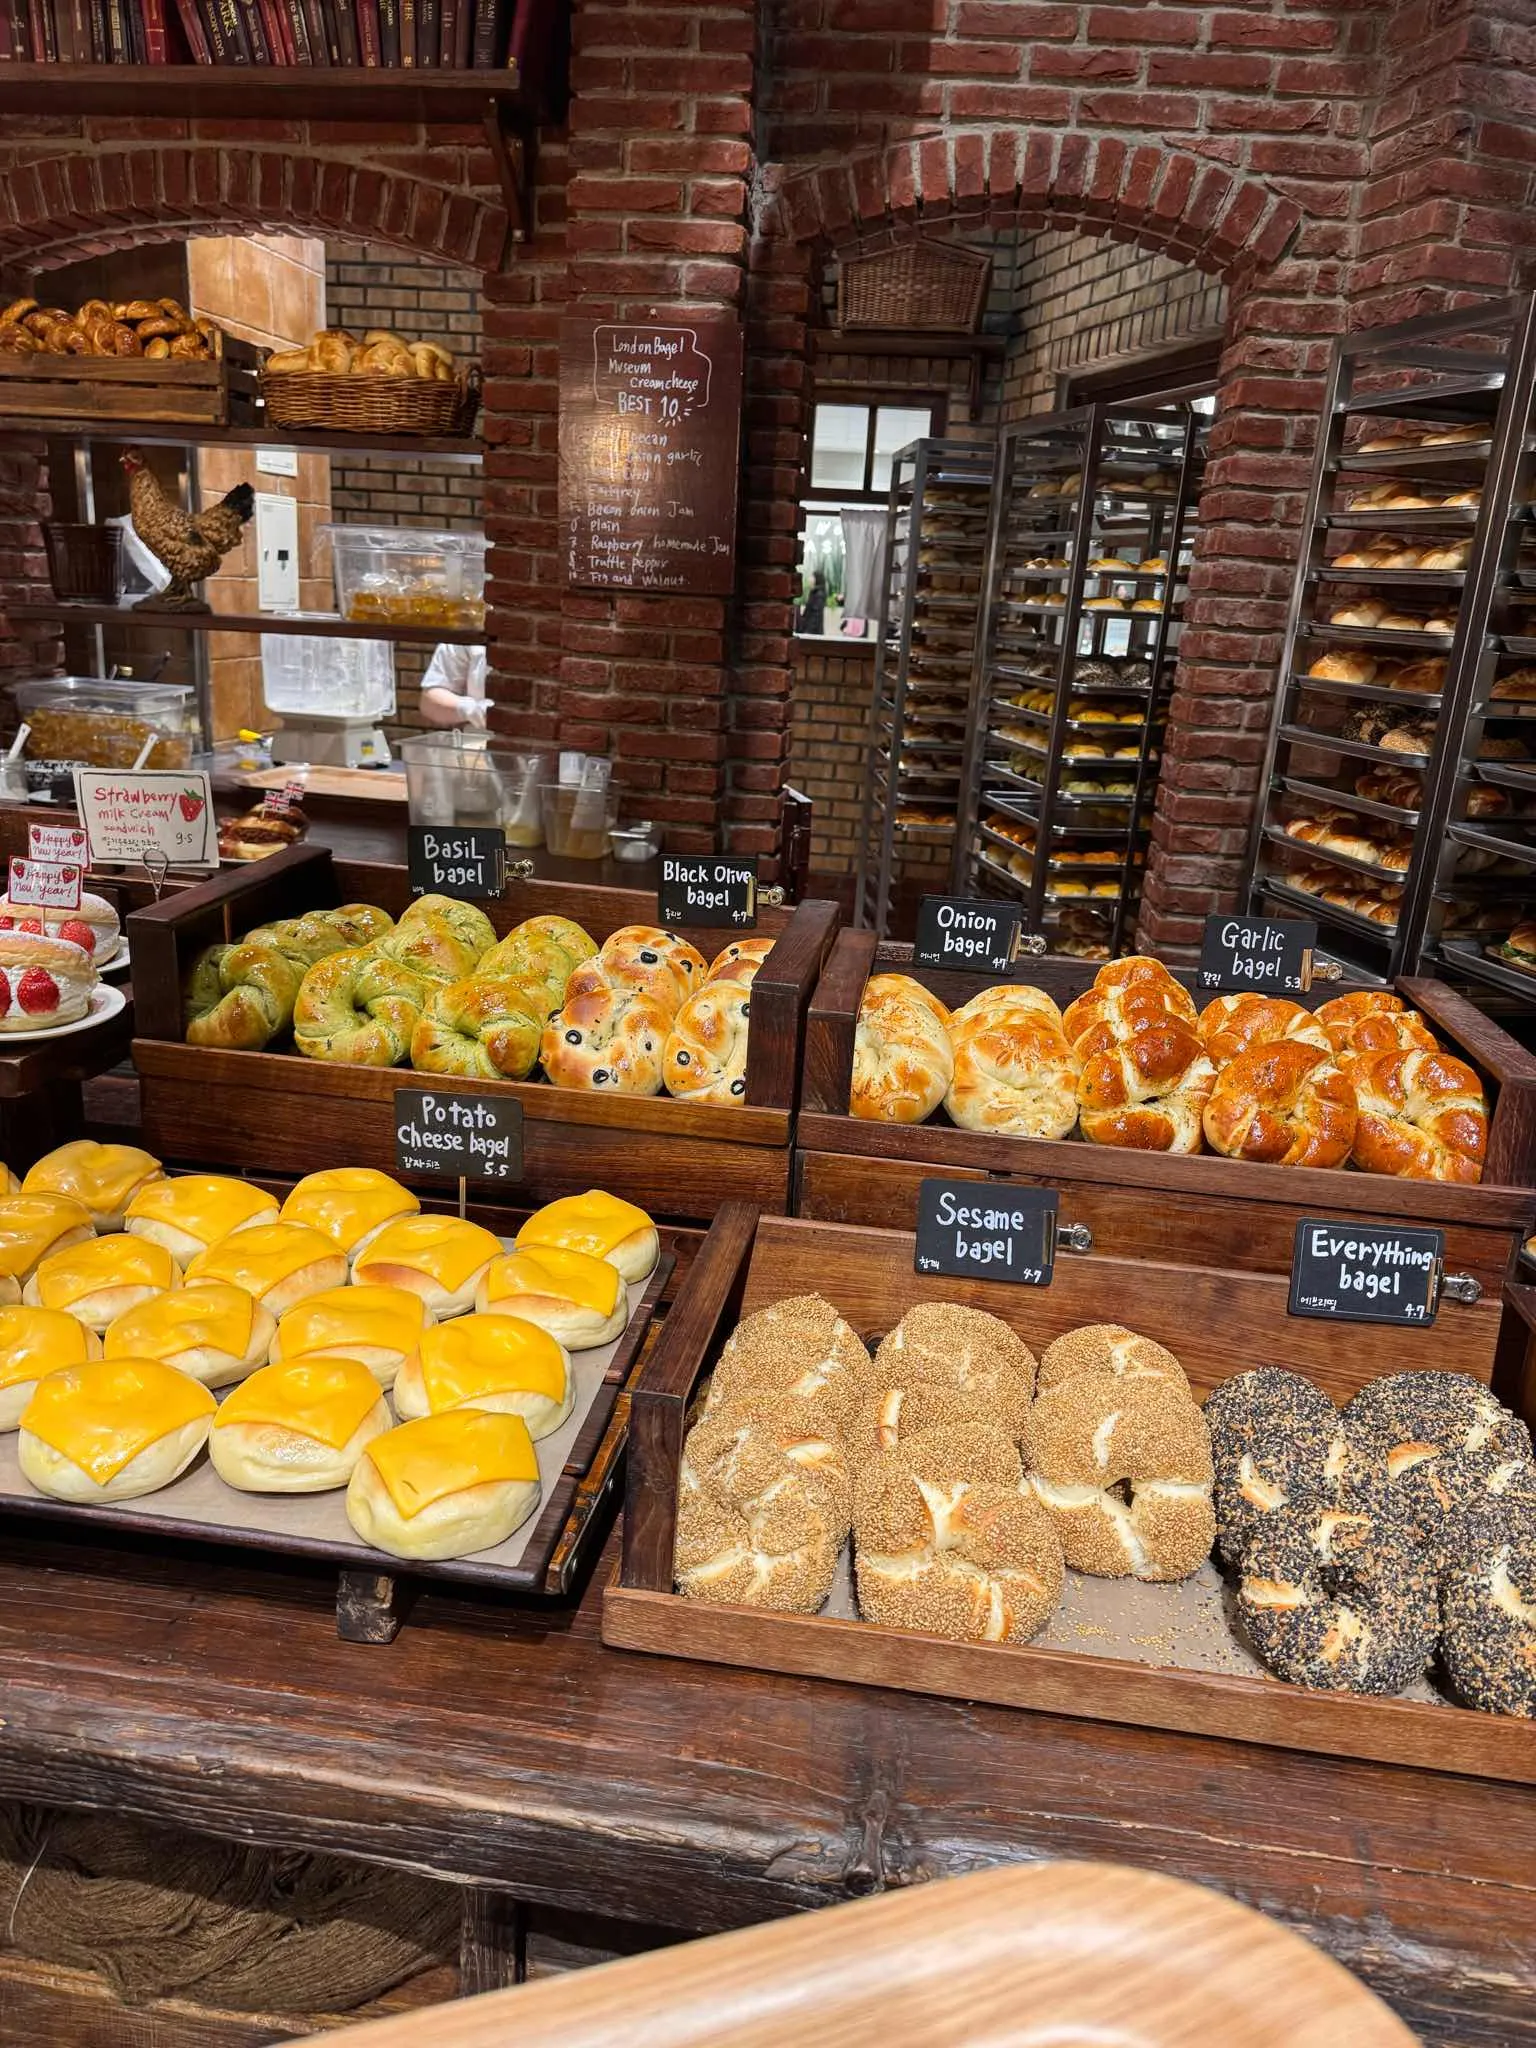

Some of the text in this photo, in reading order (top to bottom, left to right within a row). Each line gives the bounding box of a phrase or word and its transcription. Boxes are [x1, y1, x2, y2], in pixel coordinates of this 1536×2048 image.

[613, 335, 684, 360] London Bagel
[608, 358, 651, 374] Museum
[618, 392, 679, 417] BEST 10
[667, 449, 704, 466] garlic
[668, 501, 694, 518] Jam
[591, 535, 644, 556] Raspberry
[587, 555, 626, 569] Truffle
[612, 573, 633, 586] and
[94, 786, 178, 814] Strawberry
[99, 808, 125, 821] milk
[104, 820, 155, 836] sandwich
[433, 862, 483, 886] bagel
[663, 860, 752, 884] Black Olive
[687, 886, 729, 909] bagel
[937, 905, 997, 931] Onion
[943, 931, 991, 957] bagel
[1221, 922, 1285, 952] Garlic
[920, 952, 940, 962] 어니언
[1231, 952, 1281, 980] bagel
[1202, 971, 1222, 987] 갈릭
[1284, 975, 1301, 989] 5.3
[422, 1095, 497, 1129] Potato
[469, 1131, 509, 1158] bagel
[402, 1156, 441, 1170] 감자치즈
[483, 1161, 510, 1177] 5.5
[936, 1192, 1025, 1231] Sesame
[955, 1230, 1013, 1266] bagel
[1311, 1229, 1434, 1271] Everything
[919, 1255, 940, 1270] 참깨
[1339, 1263, 1400, 1299] bagel
[1404, 1303, 1426, 1320] 4.7
